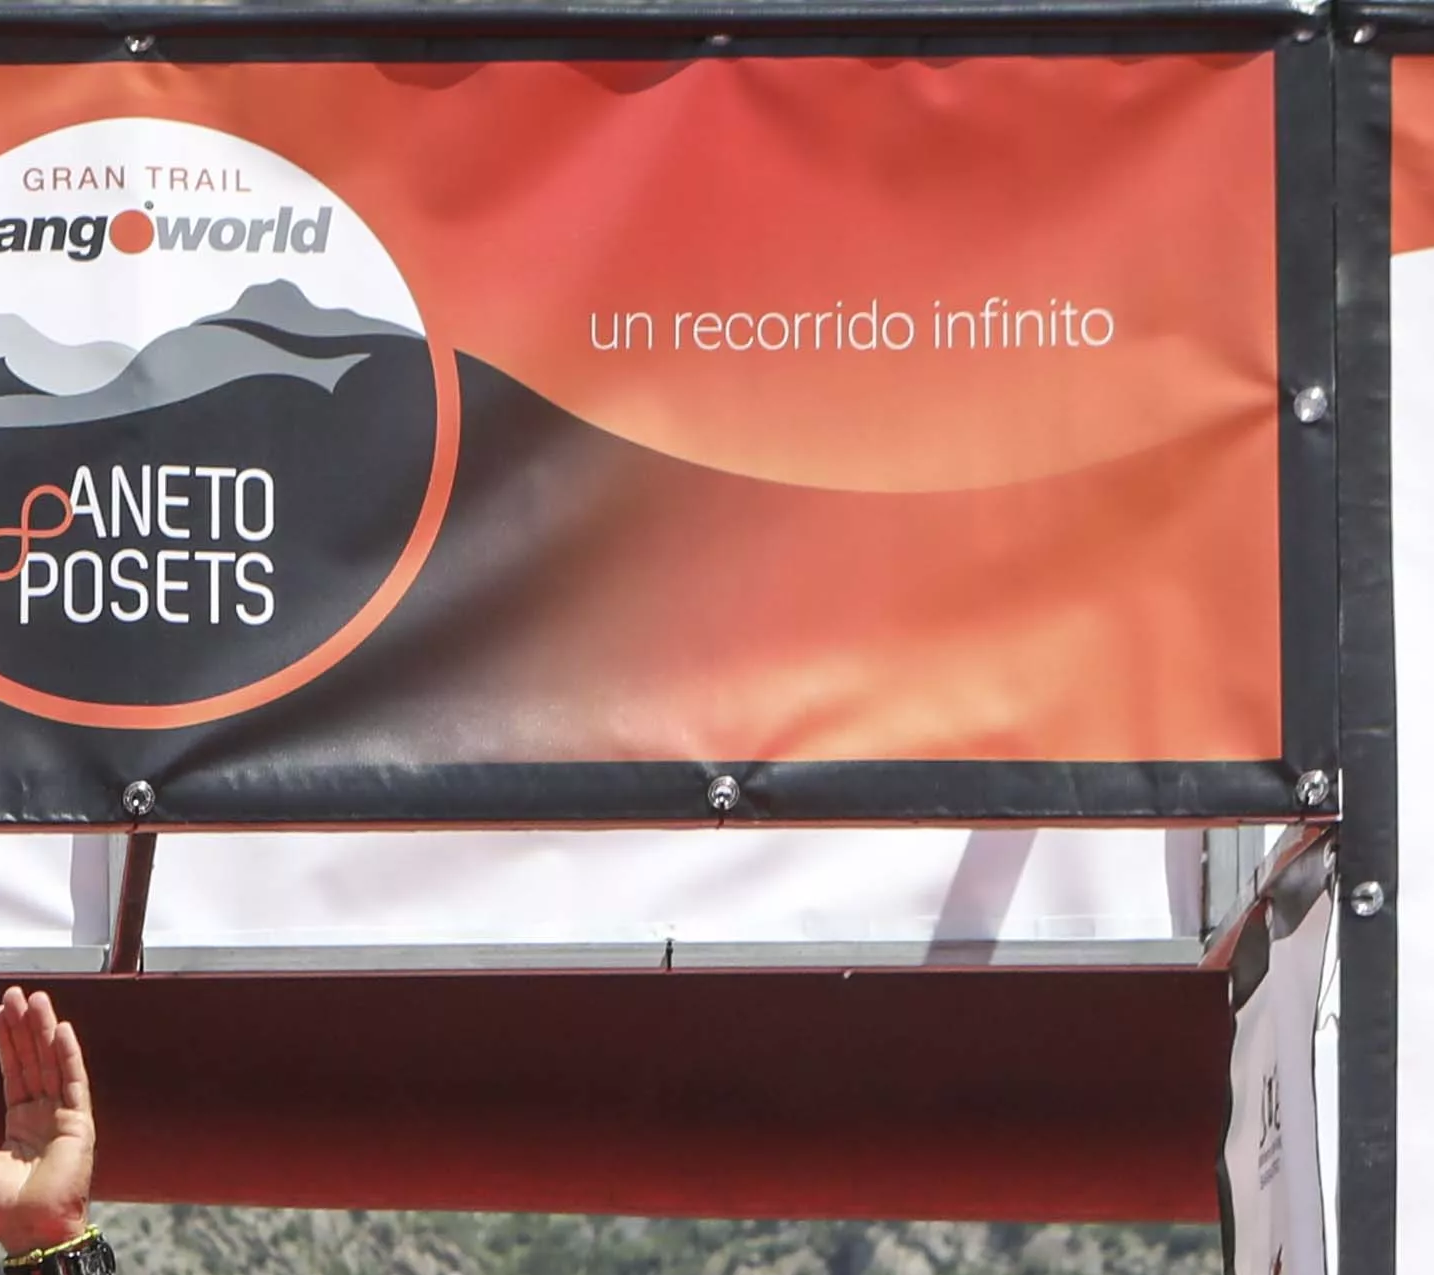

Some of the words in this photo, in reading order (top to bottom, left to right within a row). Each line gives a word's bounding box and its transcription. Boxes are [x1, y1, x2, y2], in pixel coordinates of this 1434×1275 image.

[22, 165, 126, 192] GRAN
[145, 165, 253, 193] TRAIL
[589, 311, 653, 351] un
[673, 299, 915, 351] recorrido
[933, 296, 1115, 350] infinito
[69, 464, 276, 542] ANETO
[19, 549, 276, 626] POSETS
